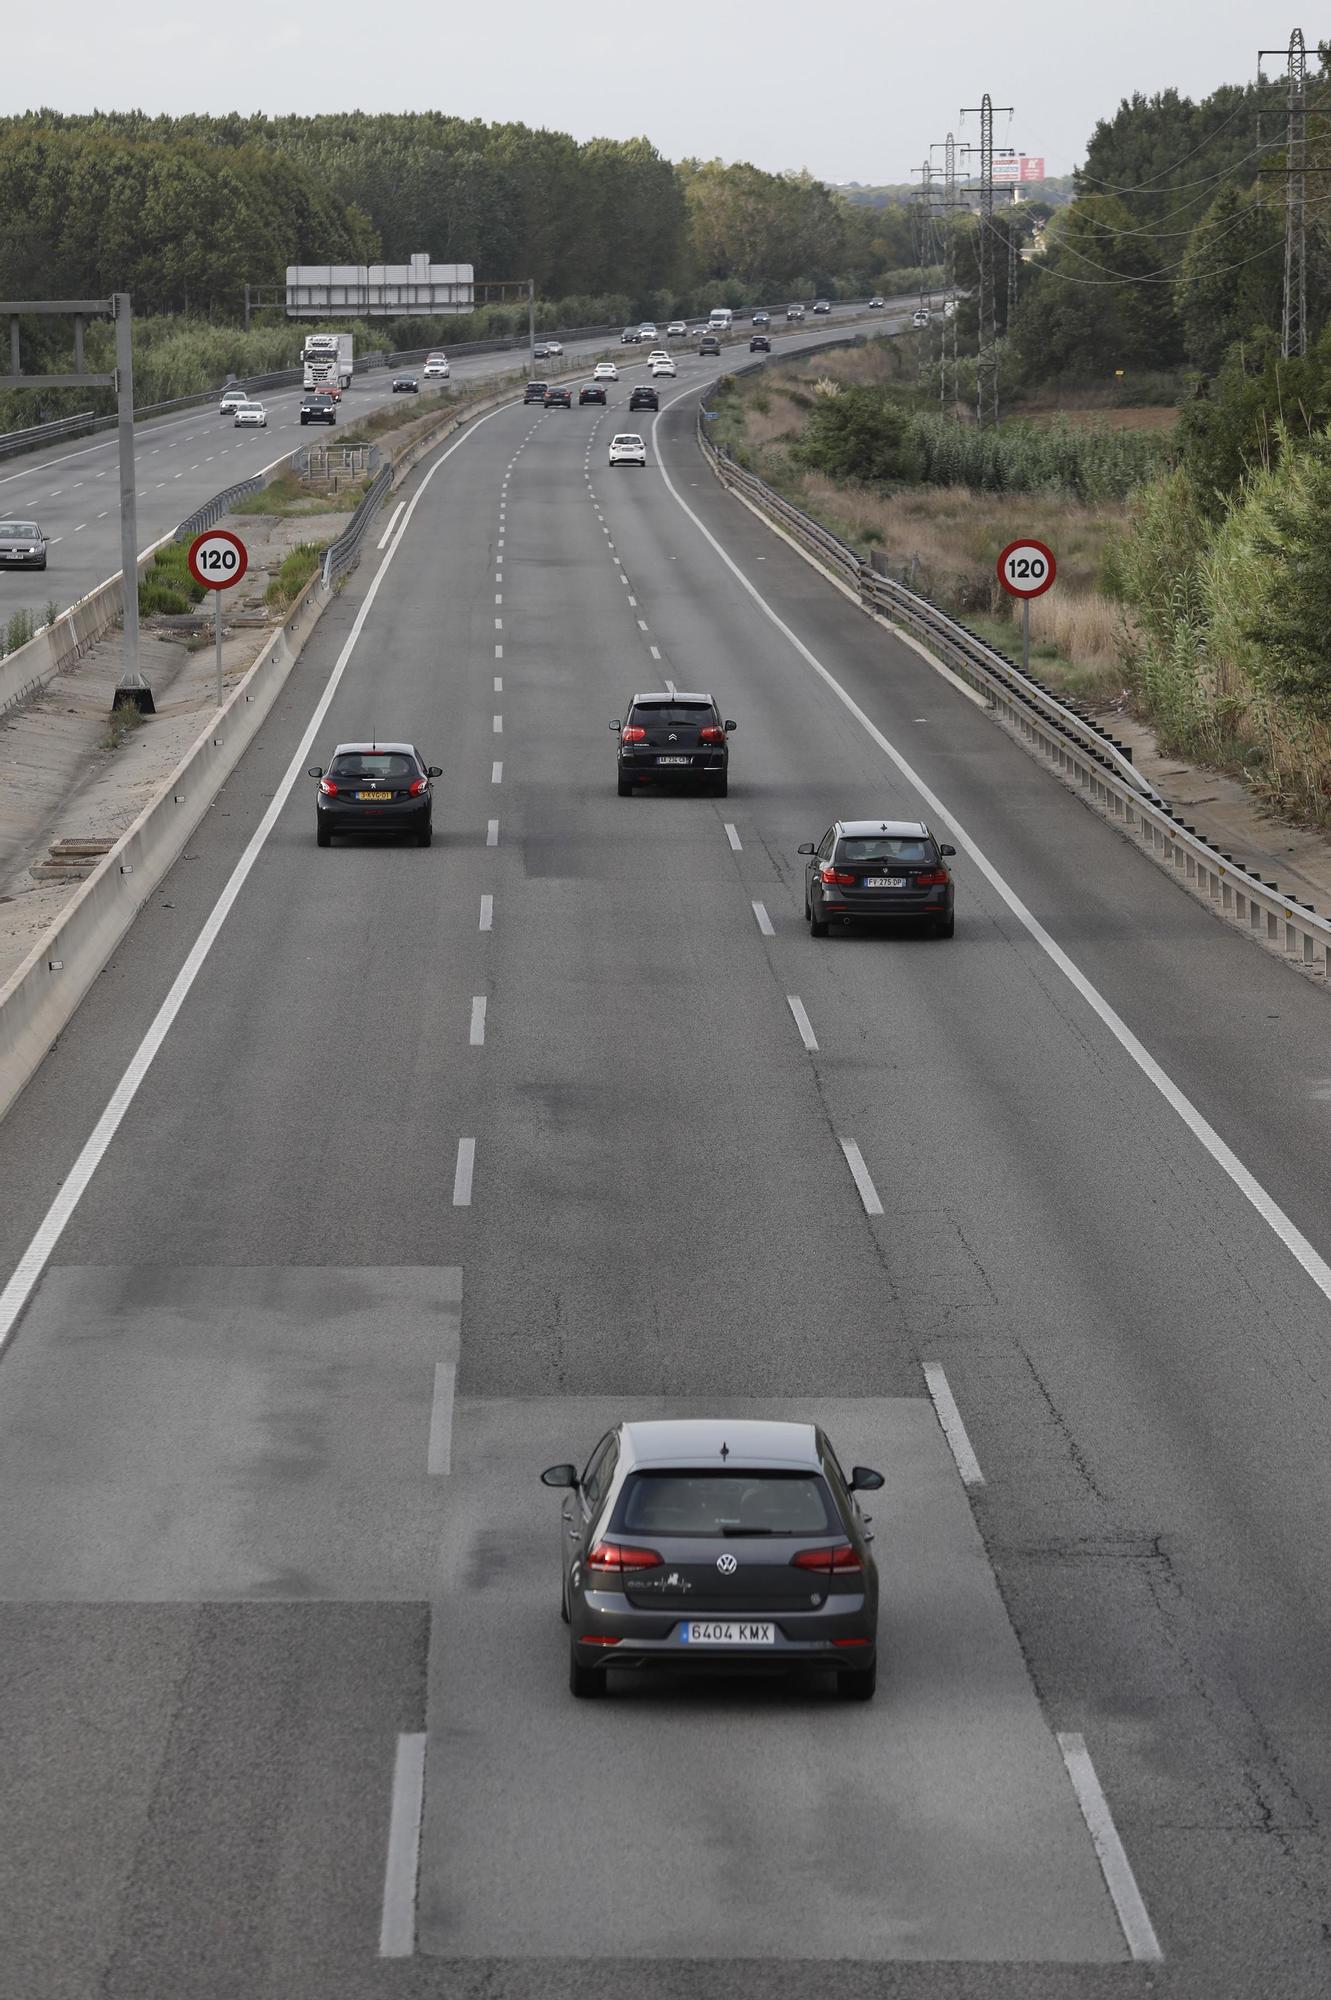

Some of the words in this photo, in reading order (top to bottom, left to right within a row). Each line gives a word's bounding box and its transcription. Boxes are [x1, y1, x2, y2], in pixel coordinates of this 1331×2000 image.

[200, 550, 236, 569] 120
[1009, 559, 1044, 578] 120
[692, 1624, 732, 1640] 6404
[739, 1625, 769, 1640] KMX
